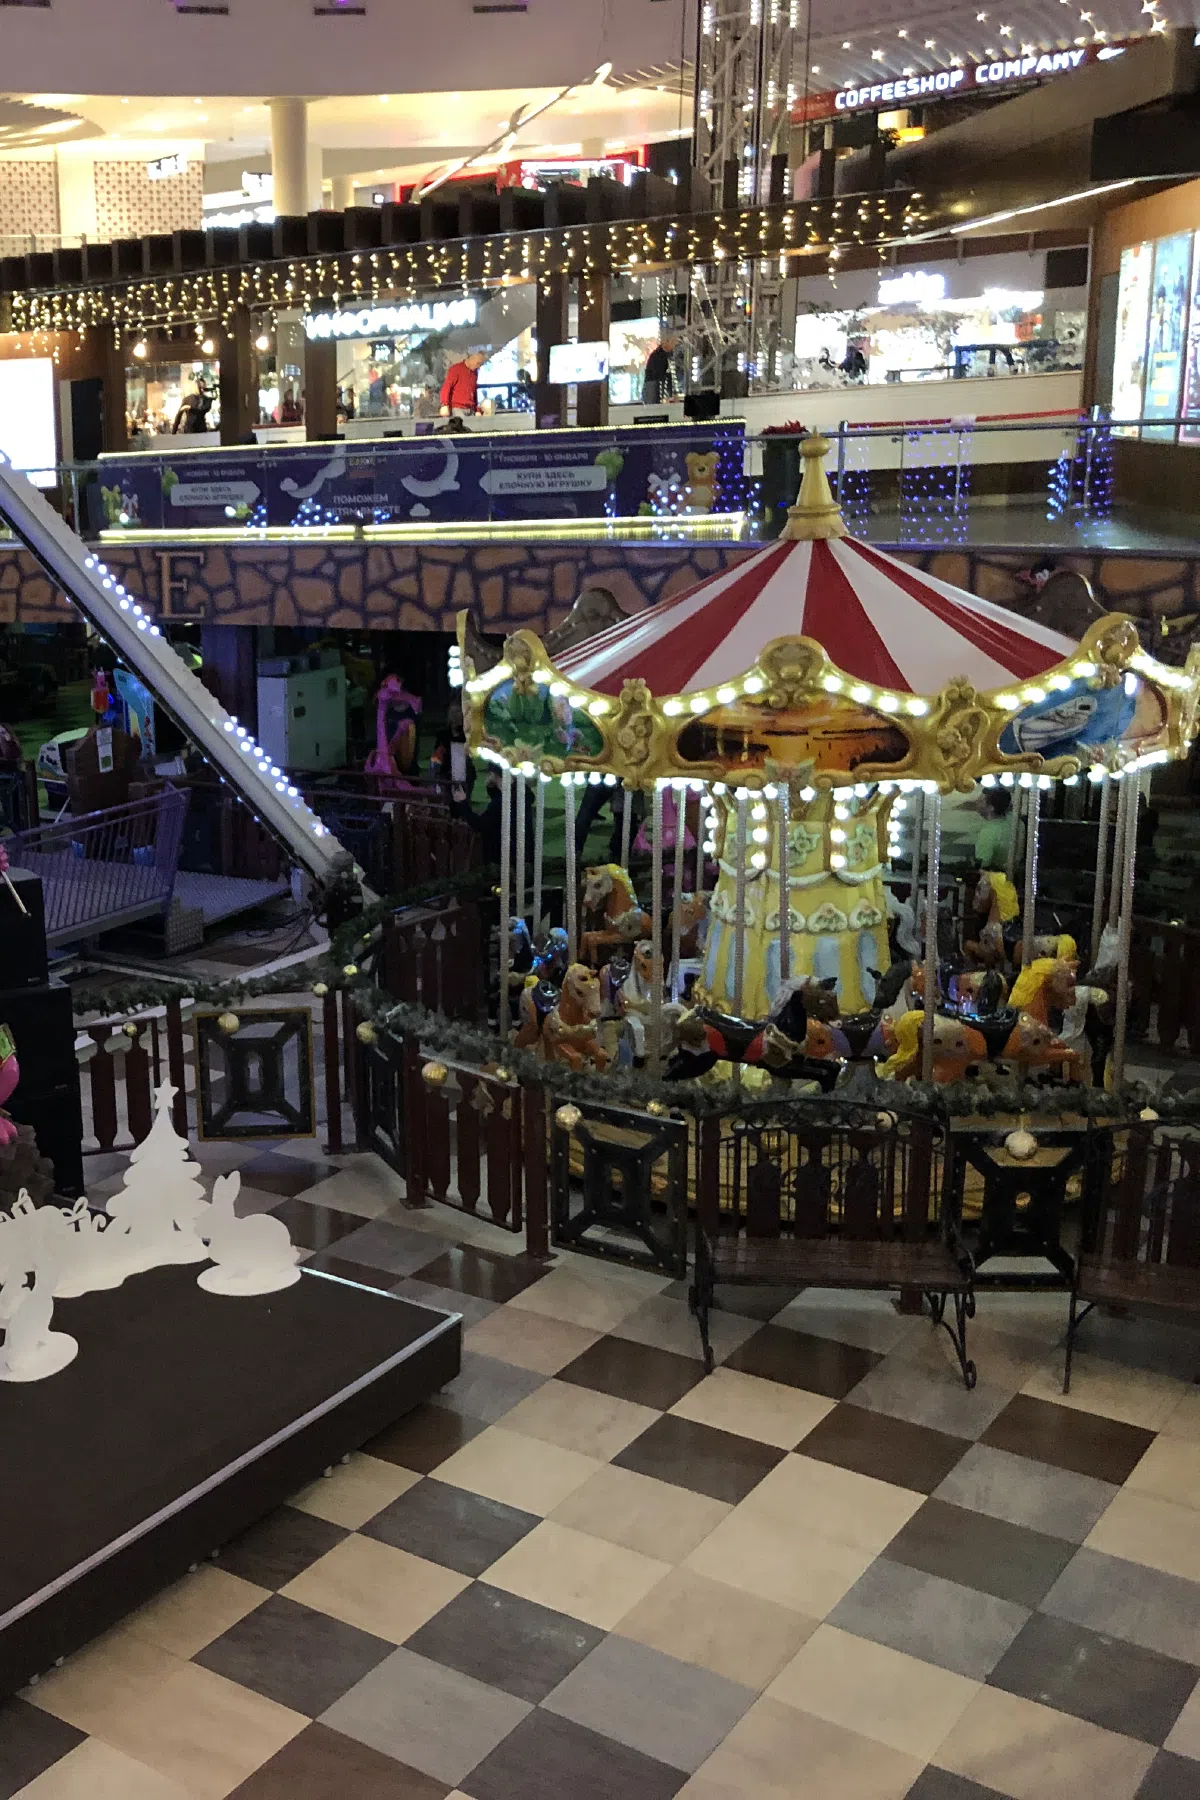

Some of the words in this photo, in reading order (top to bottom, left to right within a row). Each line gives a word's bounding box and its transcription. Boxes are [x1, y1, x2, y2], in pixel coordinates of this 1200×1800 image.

[834, 69, 964, 111] COFFEESHOP
[975, 49, 1086, 84] COMPANY
[305, 299, 477, 340] ИНФОРМАЦИЯ
[333, 493, 389, 505] ПОМОЖЕМ
